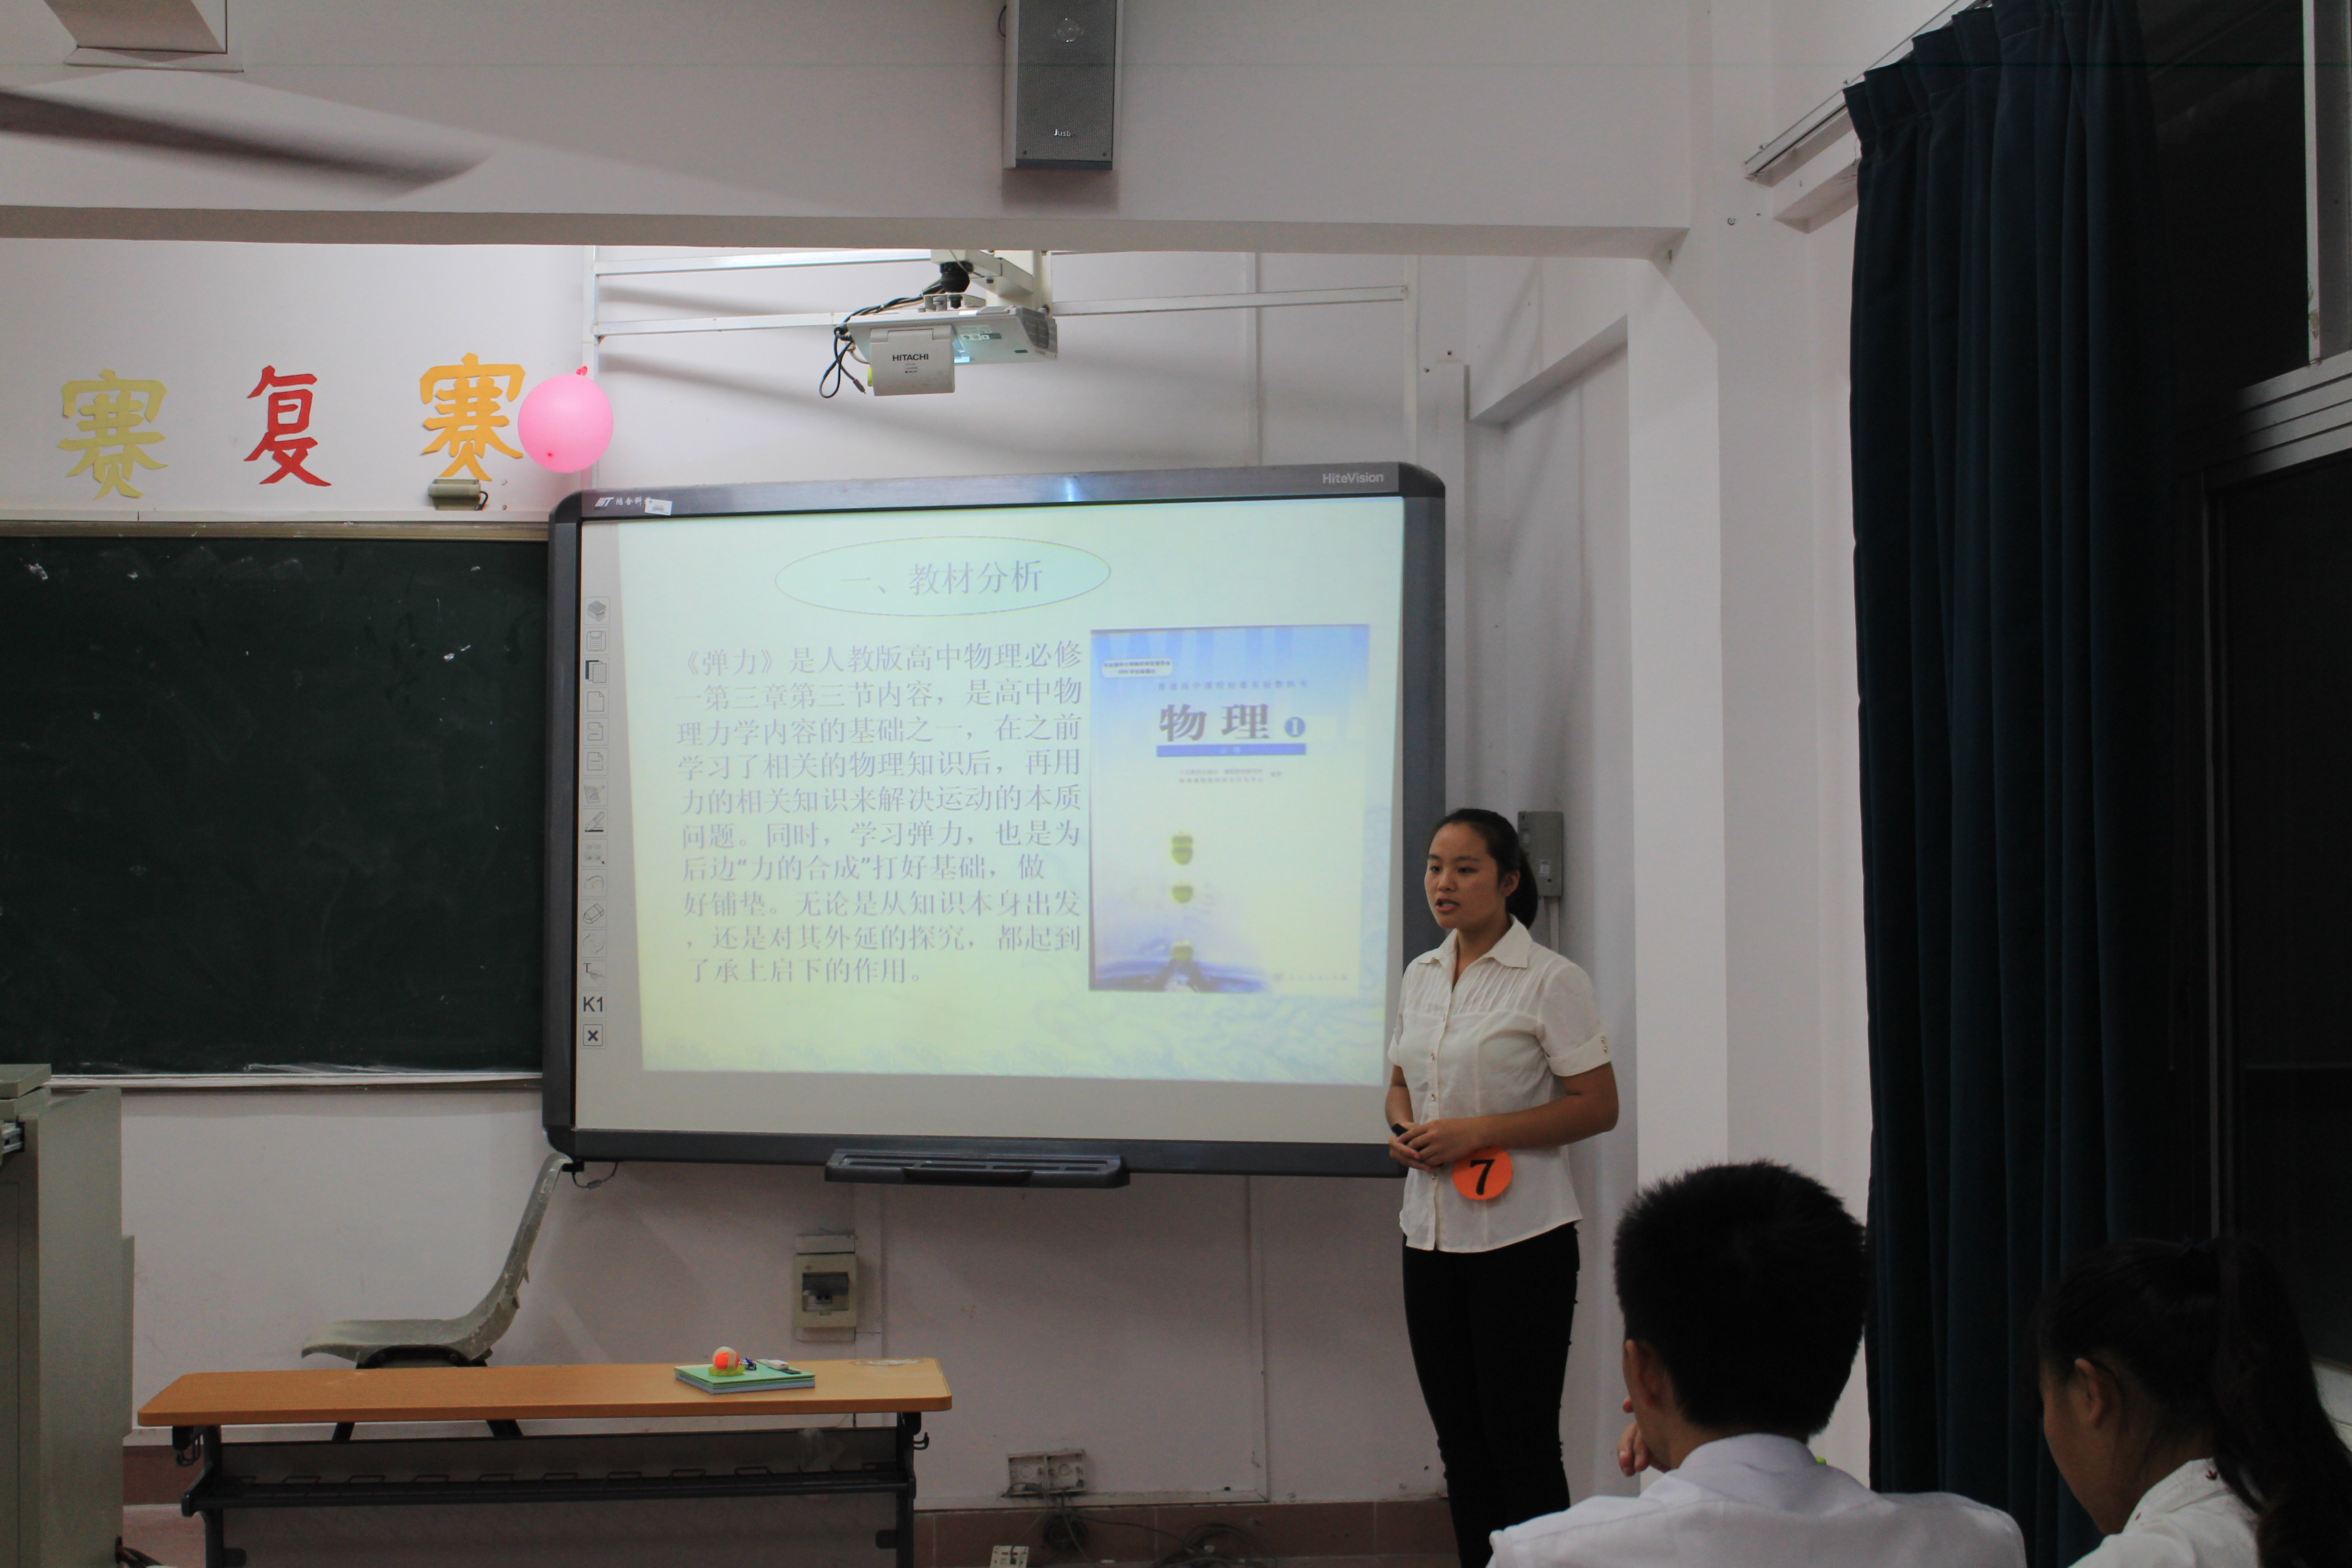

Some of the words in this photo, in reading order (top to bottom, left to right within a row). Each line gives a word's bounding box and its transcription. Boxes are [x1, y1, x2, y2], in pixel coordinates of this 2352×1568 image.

[892, 353, 929, 362] HITACHI
[1322, 472, 1384, 484] HiteVision
[840, 559, 1044, 596] 一、教材分析
[1159, 703, 1269, 742] 物理
[681, 784, 1081, 815] 力的相关知识来解决运动的本质
[583, 996, 603, 1013] K1
[1470, 1159, 1495, 1196] 7
